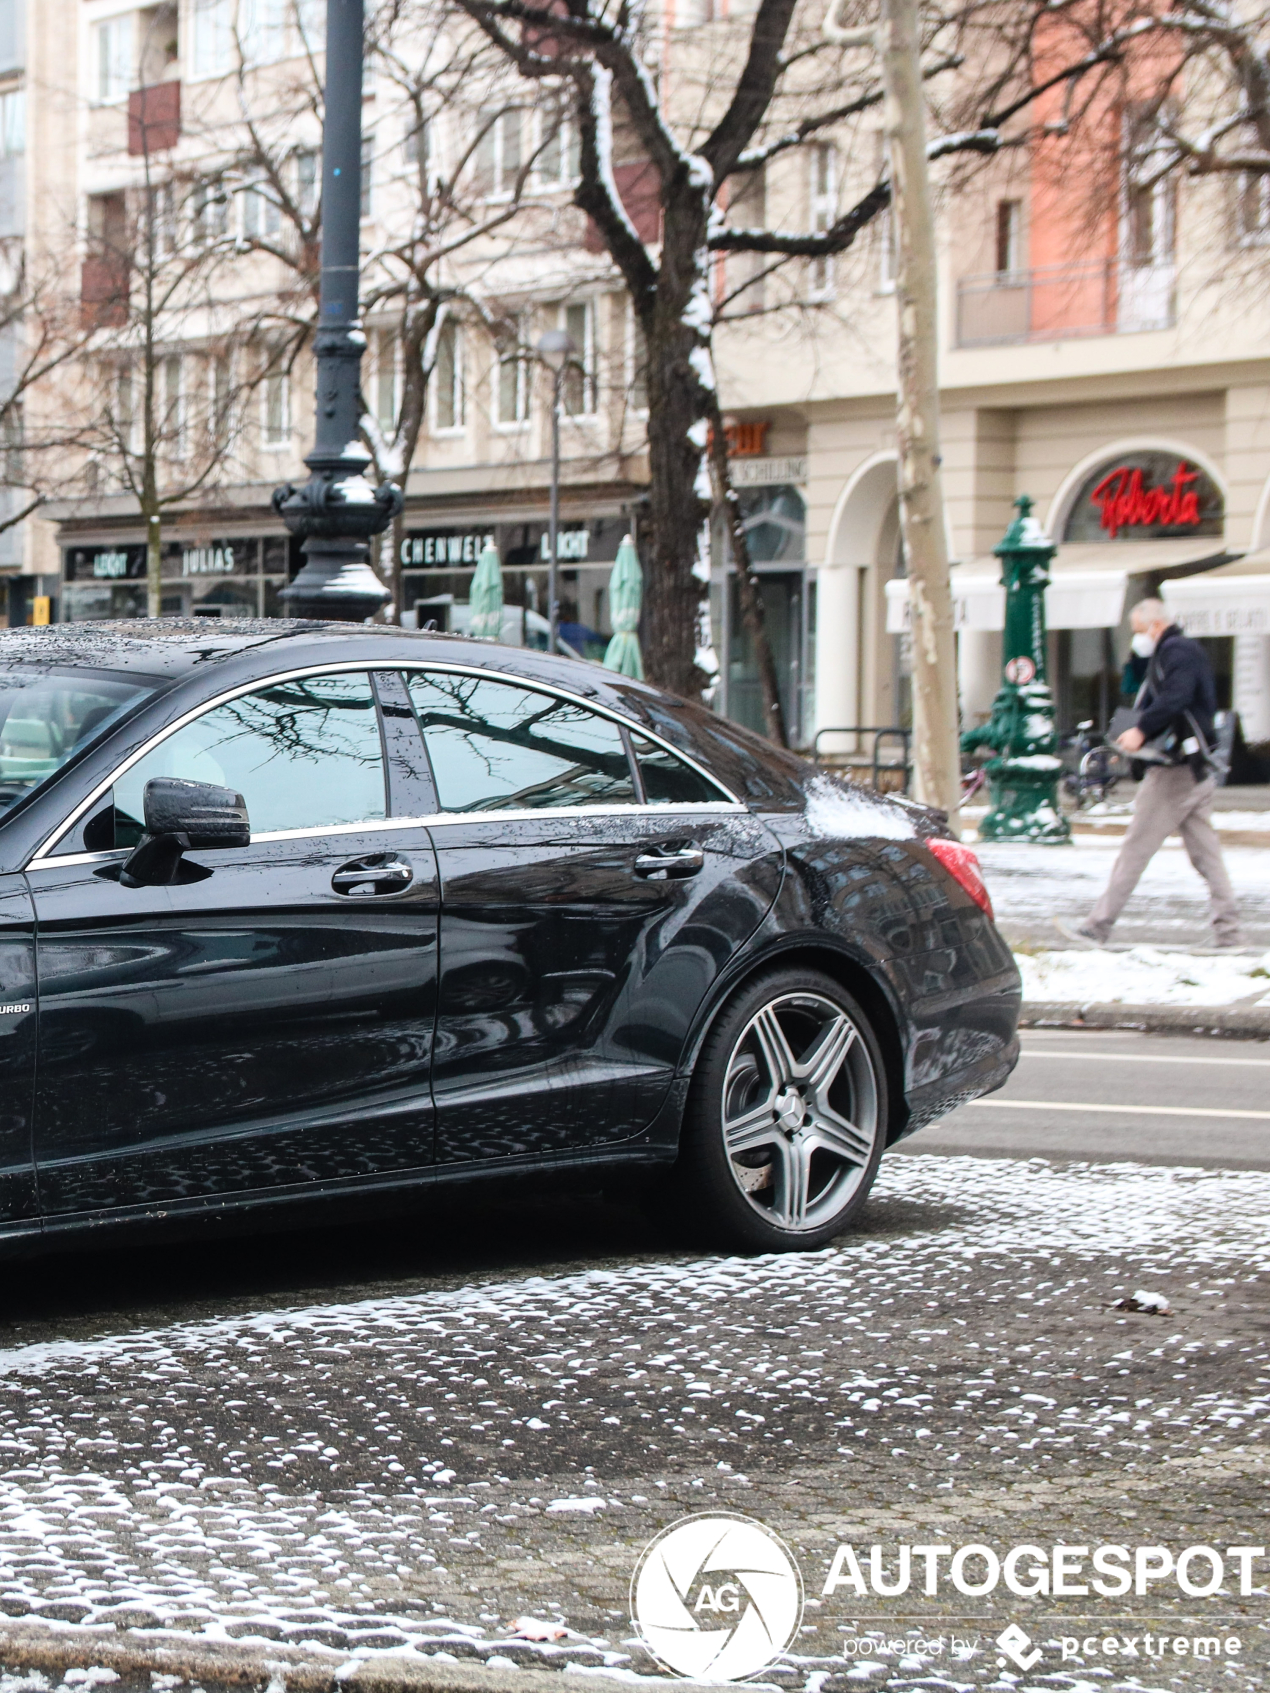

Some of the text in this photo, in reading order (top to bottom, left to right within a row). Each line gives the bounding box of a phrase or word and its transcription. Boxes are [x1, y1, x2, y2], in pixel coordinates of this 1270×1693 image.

[1091, 461, 1201, 539] Roberta
[541, 530, 590, 560] LICHT
[183, 547, 234, 577] JULIAS
